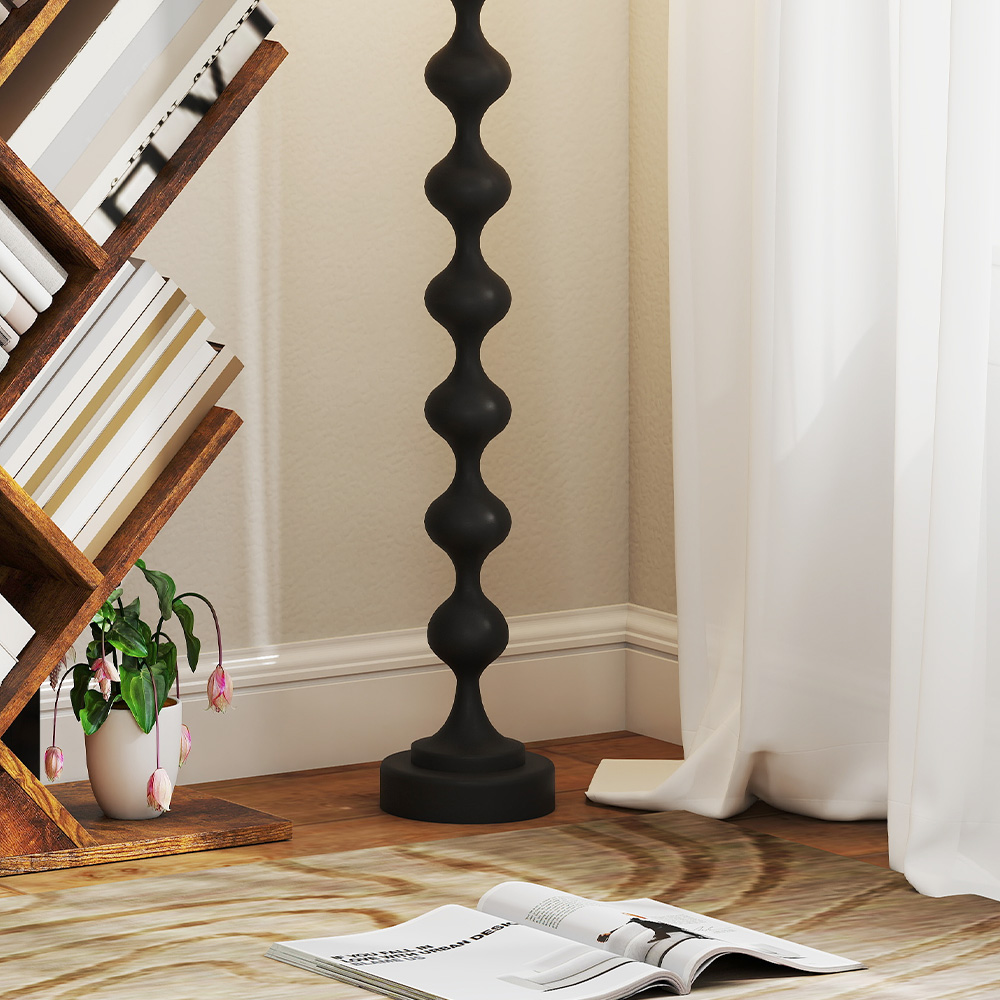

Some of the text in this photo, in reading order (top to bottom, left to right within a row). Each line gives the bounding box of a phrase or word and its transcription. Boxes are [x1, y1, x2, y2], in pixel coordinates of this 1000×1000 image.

[379, 951, 420, 960] WITH
[418, 939, 472, 955] URBAN
[469, 921, 511, 941] DESI
[379, 947, 416, 956] FALL
